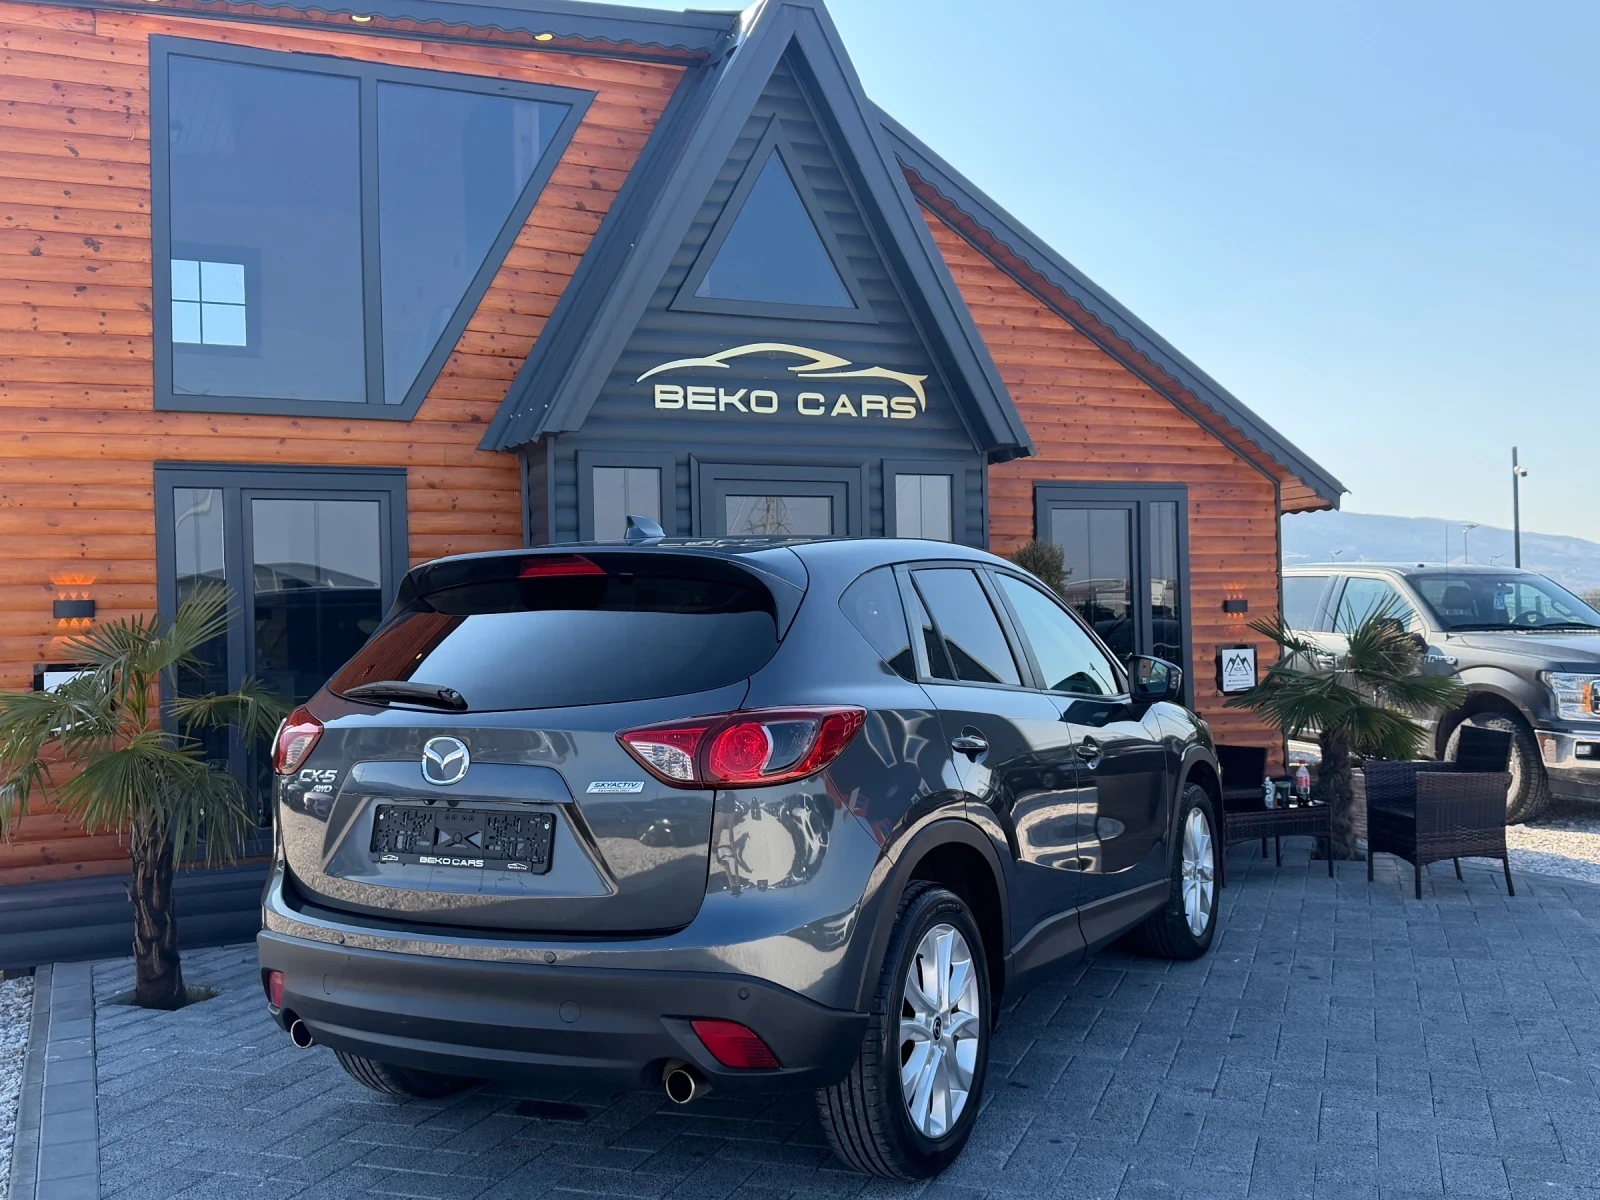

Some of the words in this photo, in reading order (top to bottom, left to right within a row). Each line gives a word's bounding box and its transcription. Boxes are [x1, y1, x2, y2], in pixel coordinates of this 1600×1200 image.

[654, 384, 778, 414] BEKO
[797, 392, 917, 419] CARS
[300, 769, 338, 783] CX-5
[311, 784, 333, 793] AWD
[419, 856, 450, 865] BEKO
[451, 859, 484, 867] CARS
